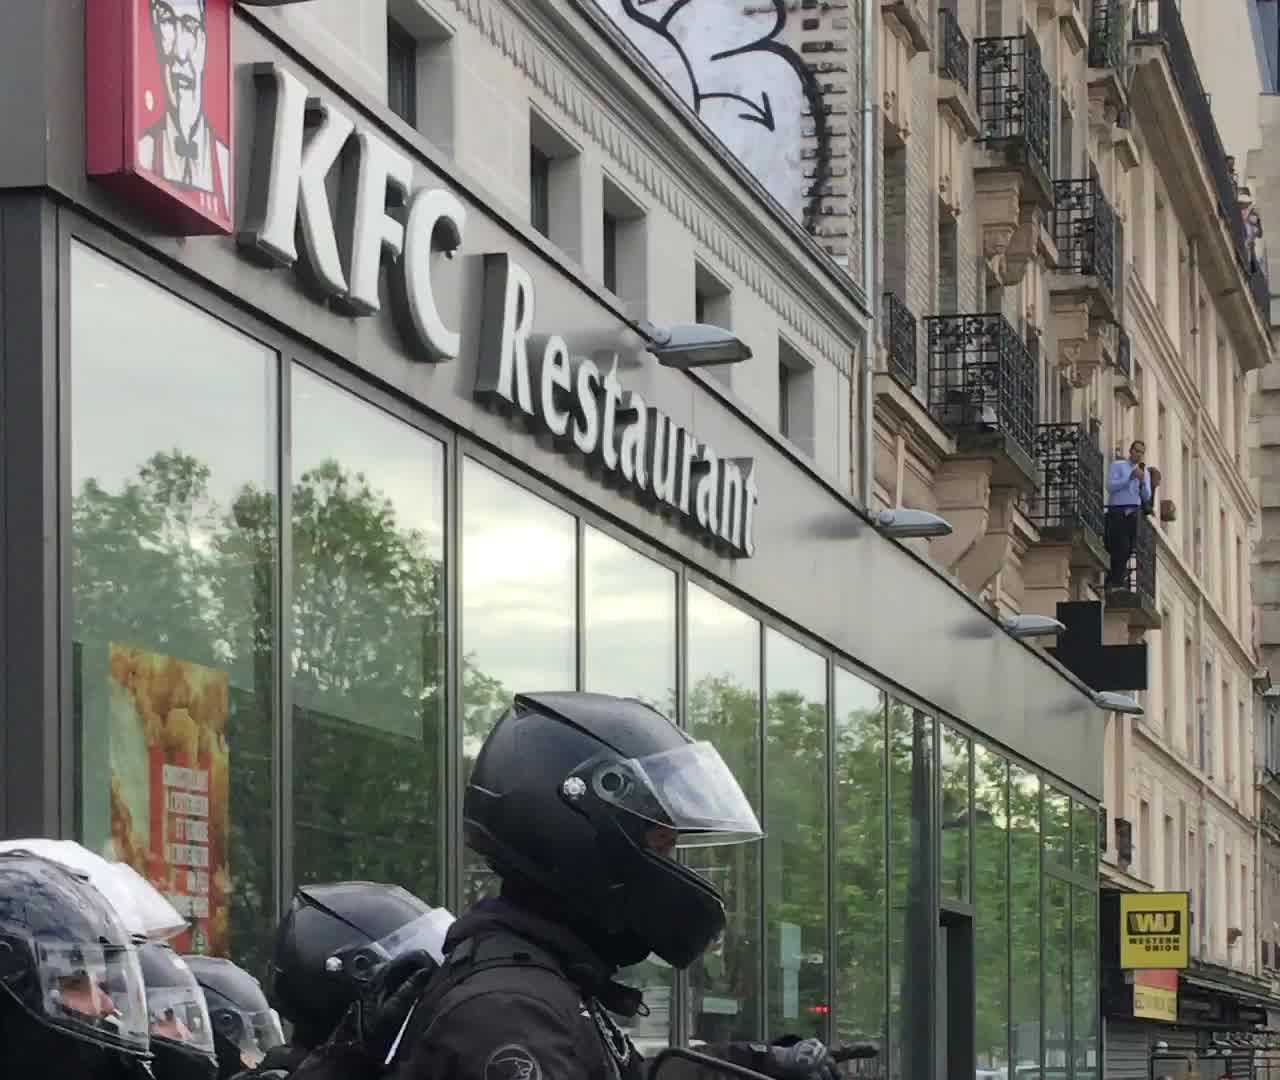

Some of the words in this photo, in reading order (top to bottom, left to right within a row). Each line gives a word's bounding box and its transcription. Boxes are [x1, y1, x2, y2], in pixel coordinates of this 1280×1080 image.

[250, 64, 466, 362] KFC
[492, 254, 760, 560] Restaurant
[1129, 937, 1180, 945] WESTERN
[1144, 944, 1180, 952] UNION
